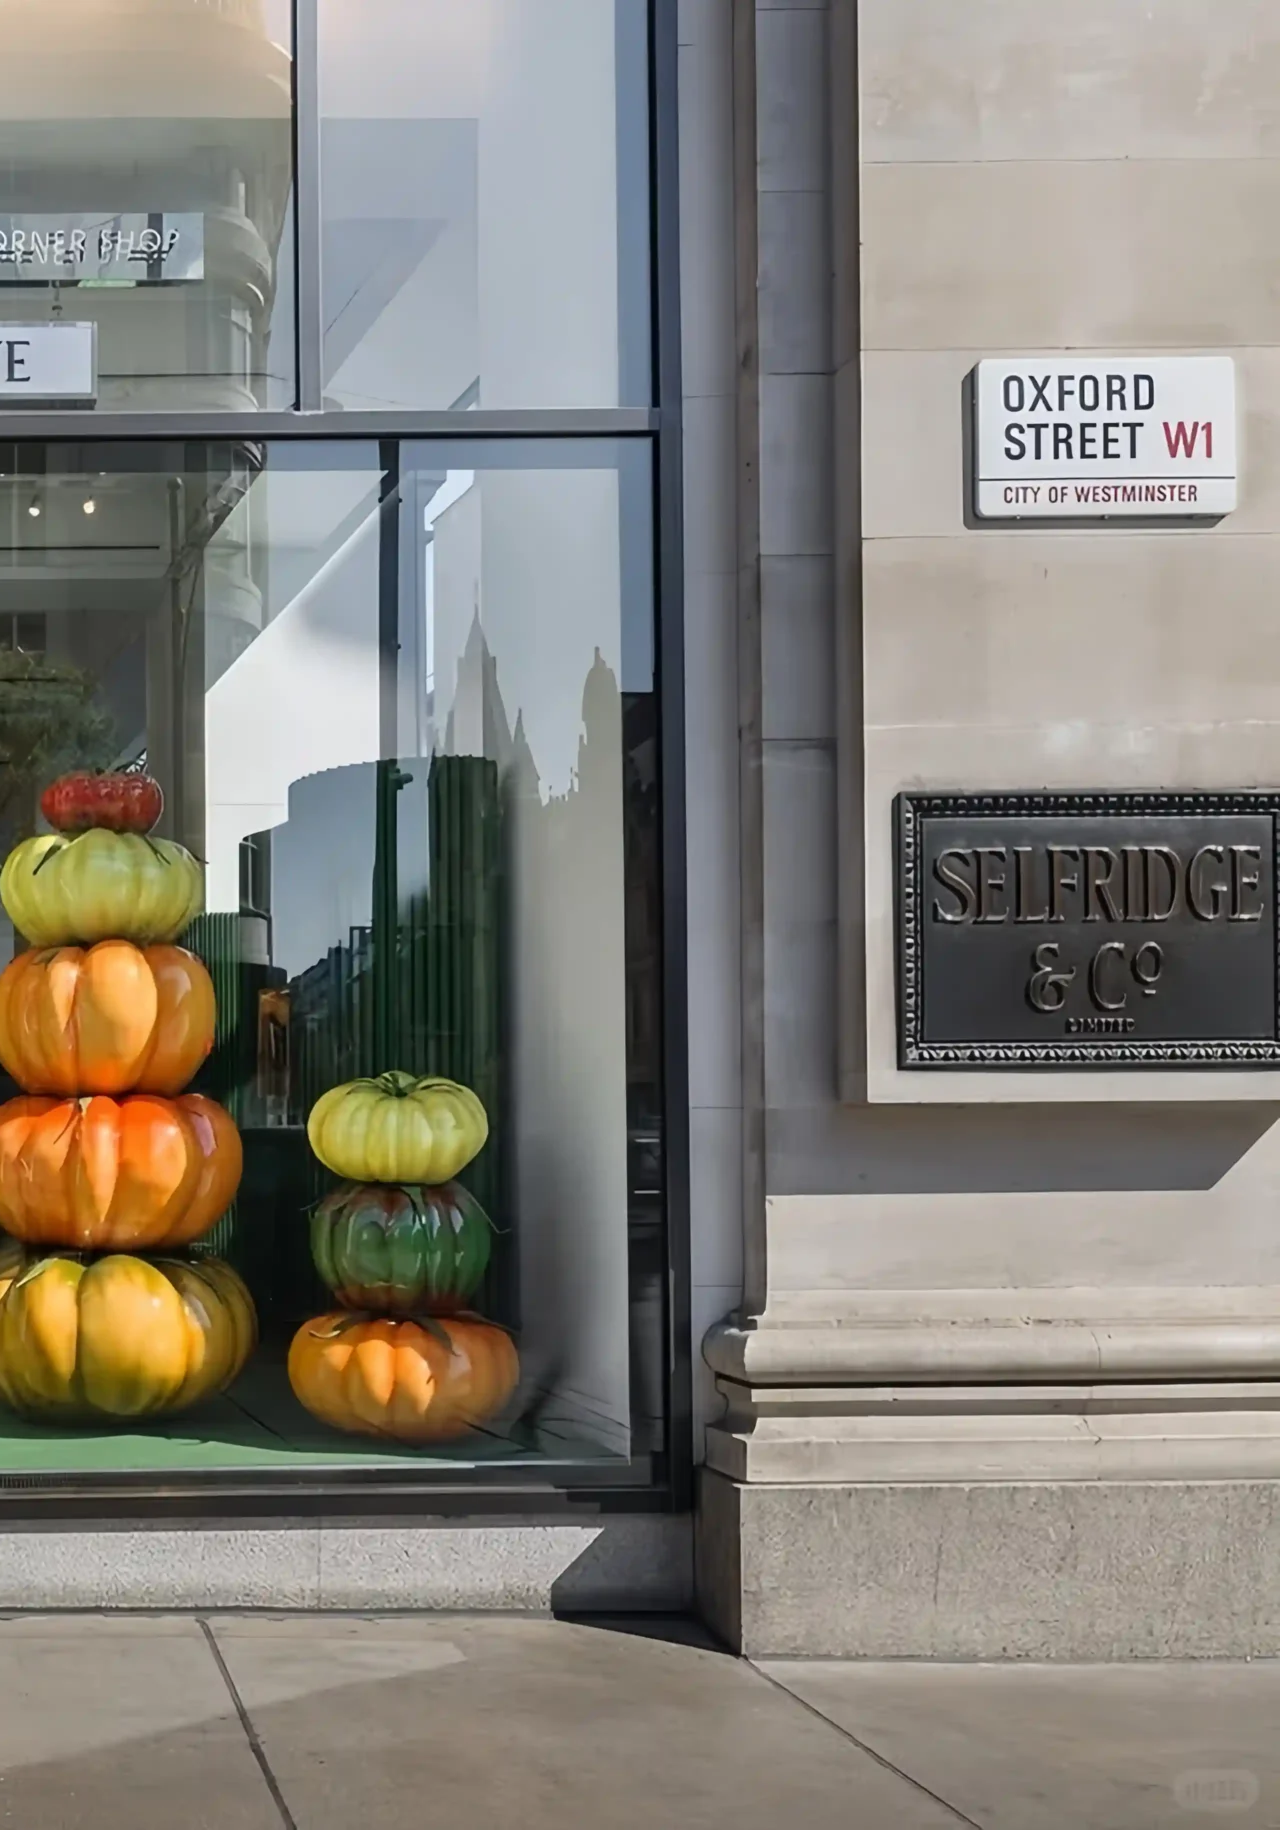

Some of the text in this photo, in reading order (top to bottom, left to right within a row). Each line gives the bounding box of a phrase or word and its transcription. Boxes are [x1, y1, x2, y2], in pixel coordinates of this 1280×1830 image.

[100, 228, 180, 257] SHOP
[1003, 374, 1155, 412] OXFORD
[1004, 421, 1213, 460] STREET W1
[1003, 485, 1198, 503] CITY OF WESTMINSTER
[932, 844, 1265, 924] SELFRIDGE
[1027, 942, 1076, 1012] &
